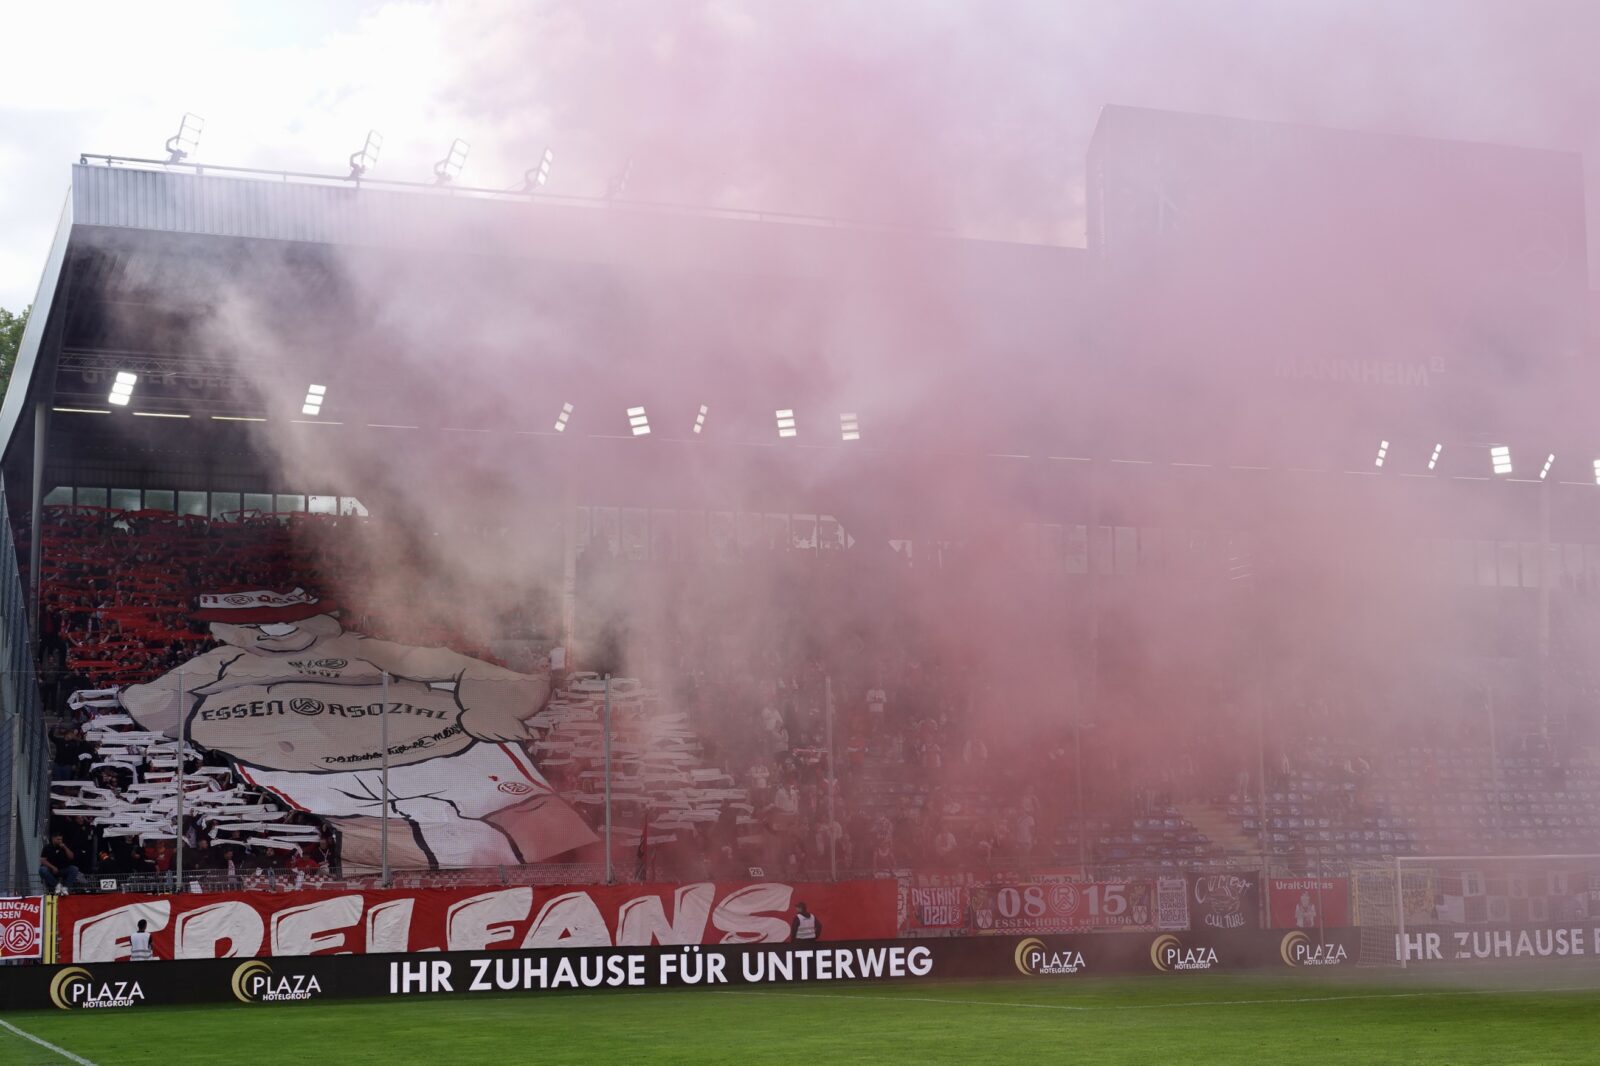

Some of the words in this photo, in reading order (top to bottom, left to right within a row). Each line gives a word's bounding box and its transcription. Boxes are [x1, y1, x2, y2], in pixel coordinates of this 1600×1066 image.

[202, 700, 285, 722] ESSEN
[102, 880, 114, 889] 27
[1296, 943, 1348, 961] PLAZA
[1395, 932, 1443, 961] IHR
[1454, 928, 1584, 959] ZUHAUSE
[1032, 951, 1086, 968] PLAZA
[1167, 947, 1219, 965] PLAZA
[389, 961, 454, 994] IHR
[468, 953, 646, 992] ZUHAUSE
[658, 946, 729, 985] FÜR
[740, 945, 934, 982] UNTERWEG
[73, 981, 145, 1002] PLAZA
[253, 975, 322, 995] PLAZA
[82, 999, 134, 1009] HOTELGROUP
[262, 993, 312, 1001] HOTELGROUP
